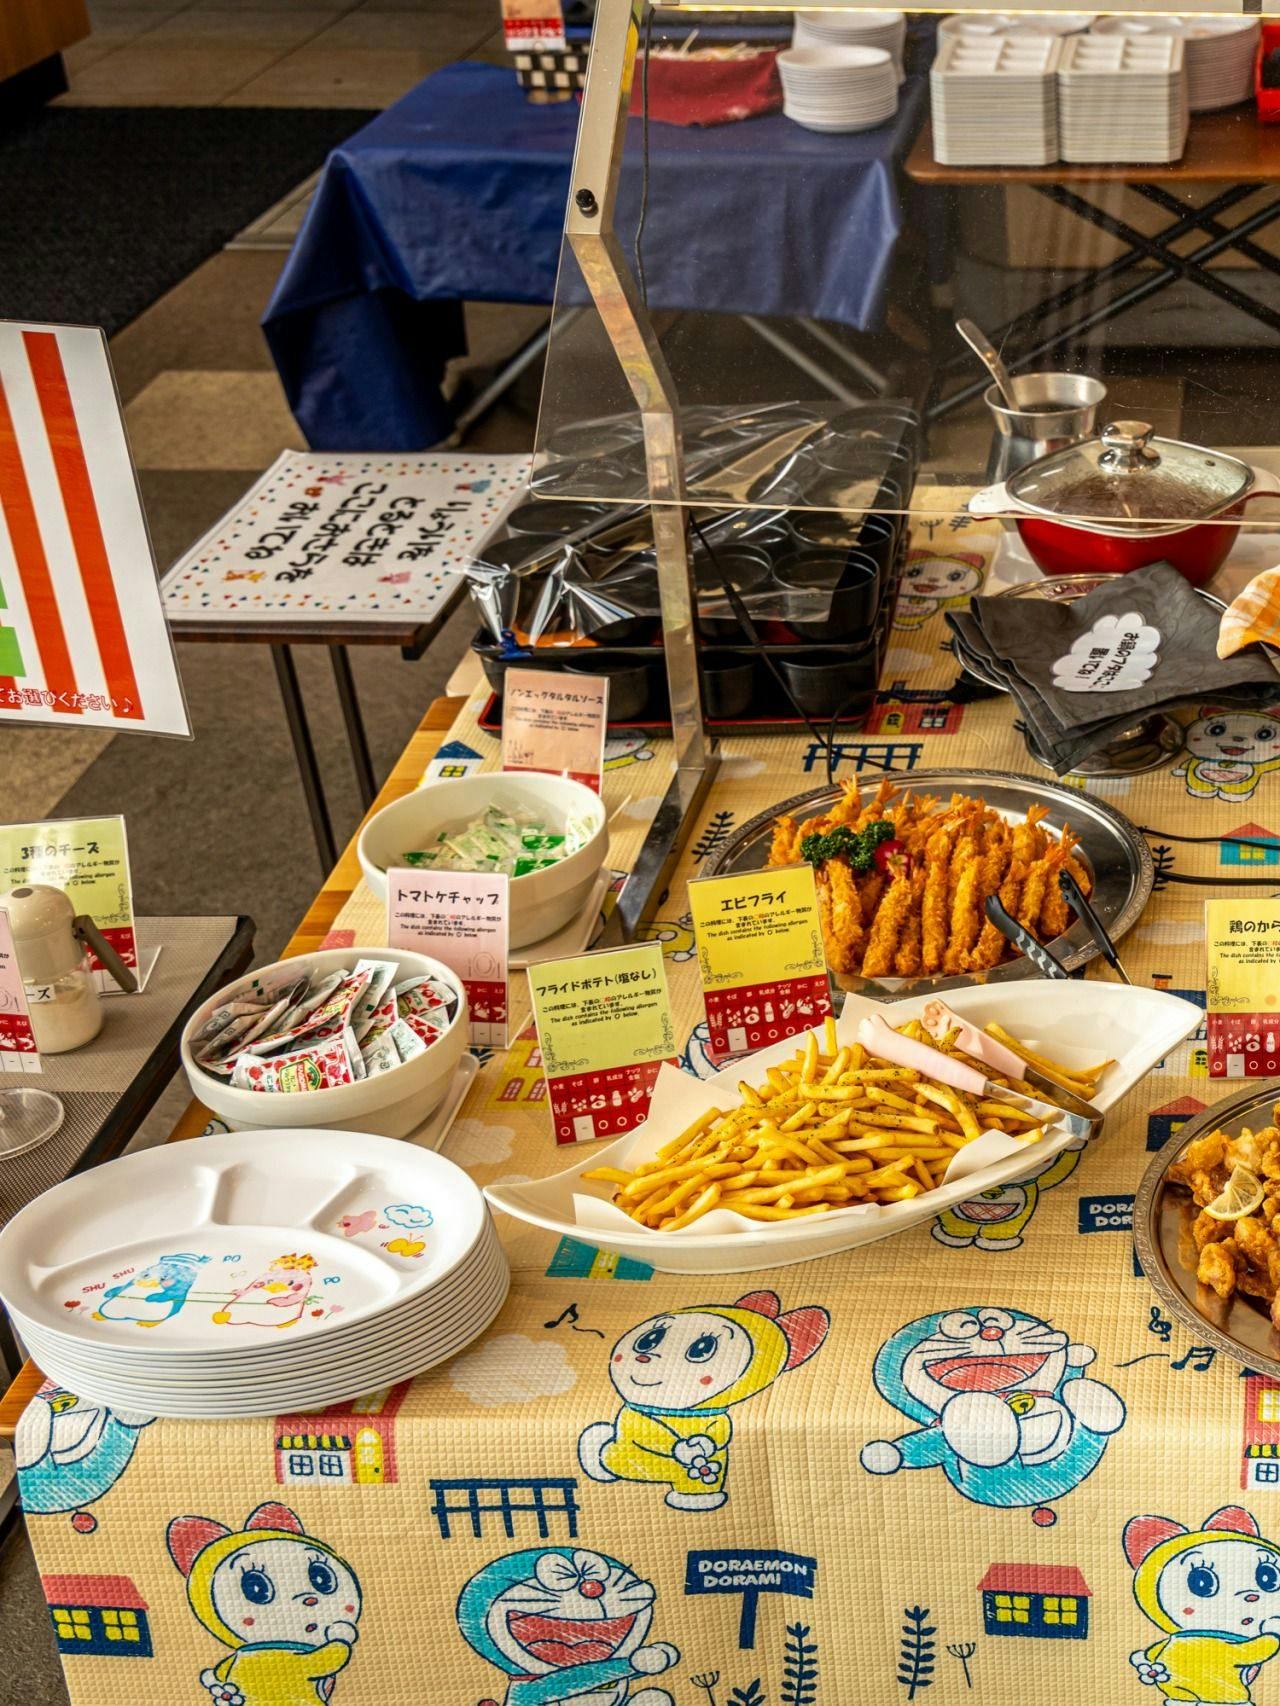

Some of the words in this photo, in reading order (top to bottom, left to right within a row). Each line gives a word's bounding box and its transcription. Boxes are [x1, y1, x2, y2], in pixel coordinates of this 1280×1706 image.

[244, 502, 320, 560] おいてね
[275, 482, 387, 584] ここにおさらを
[342, 497, 425, 567] とるときは
[398, 501, 472, 561] りょうりを
[1088, 632, 1140, 688] お鍋のフタはここ
[398, 890, 499, 905] トマトケチャップ
[721, 891, 786, 911] エビフライ
[536, 968, 657, 997] フライドポテト(塩なし)
[1089, 1203, 1134, 1214] DORA
[1095, 1216, 1133, 1226] DOR
[223, 1254, 241, 1263] PO
[112, 1267, 135, 1279] SHU
[324, 1276, 340, 1285] PO
[82, 1282, 105, 1293] SHU
[698, 1560, 807, 1575] DORAEMON
[704, 1573, 781, 1588] DORAMI
